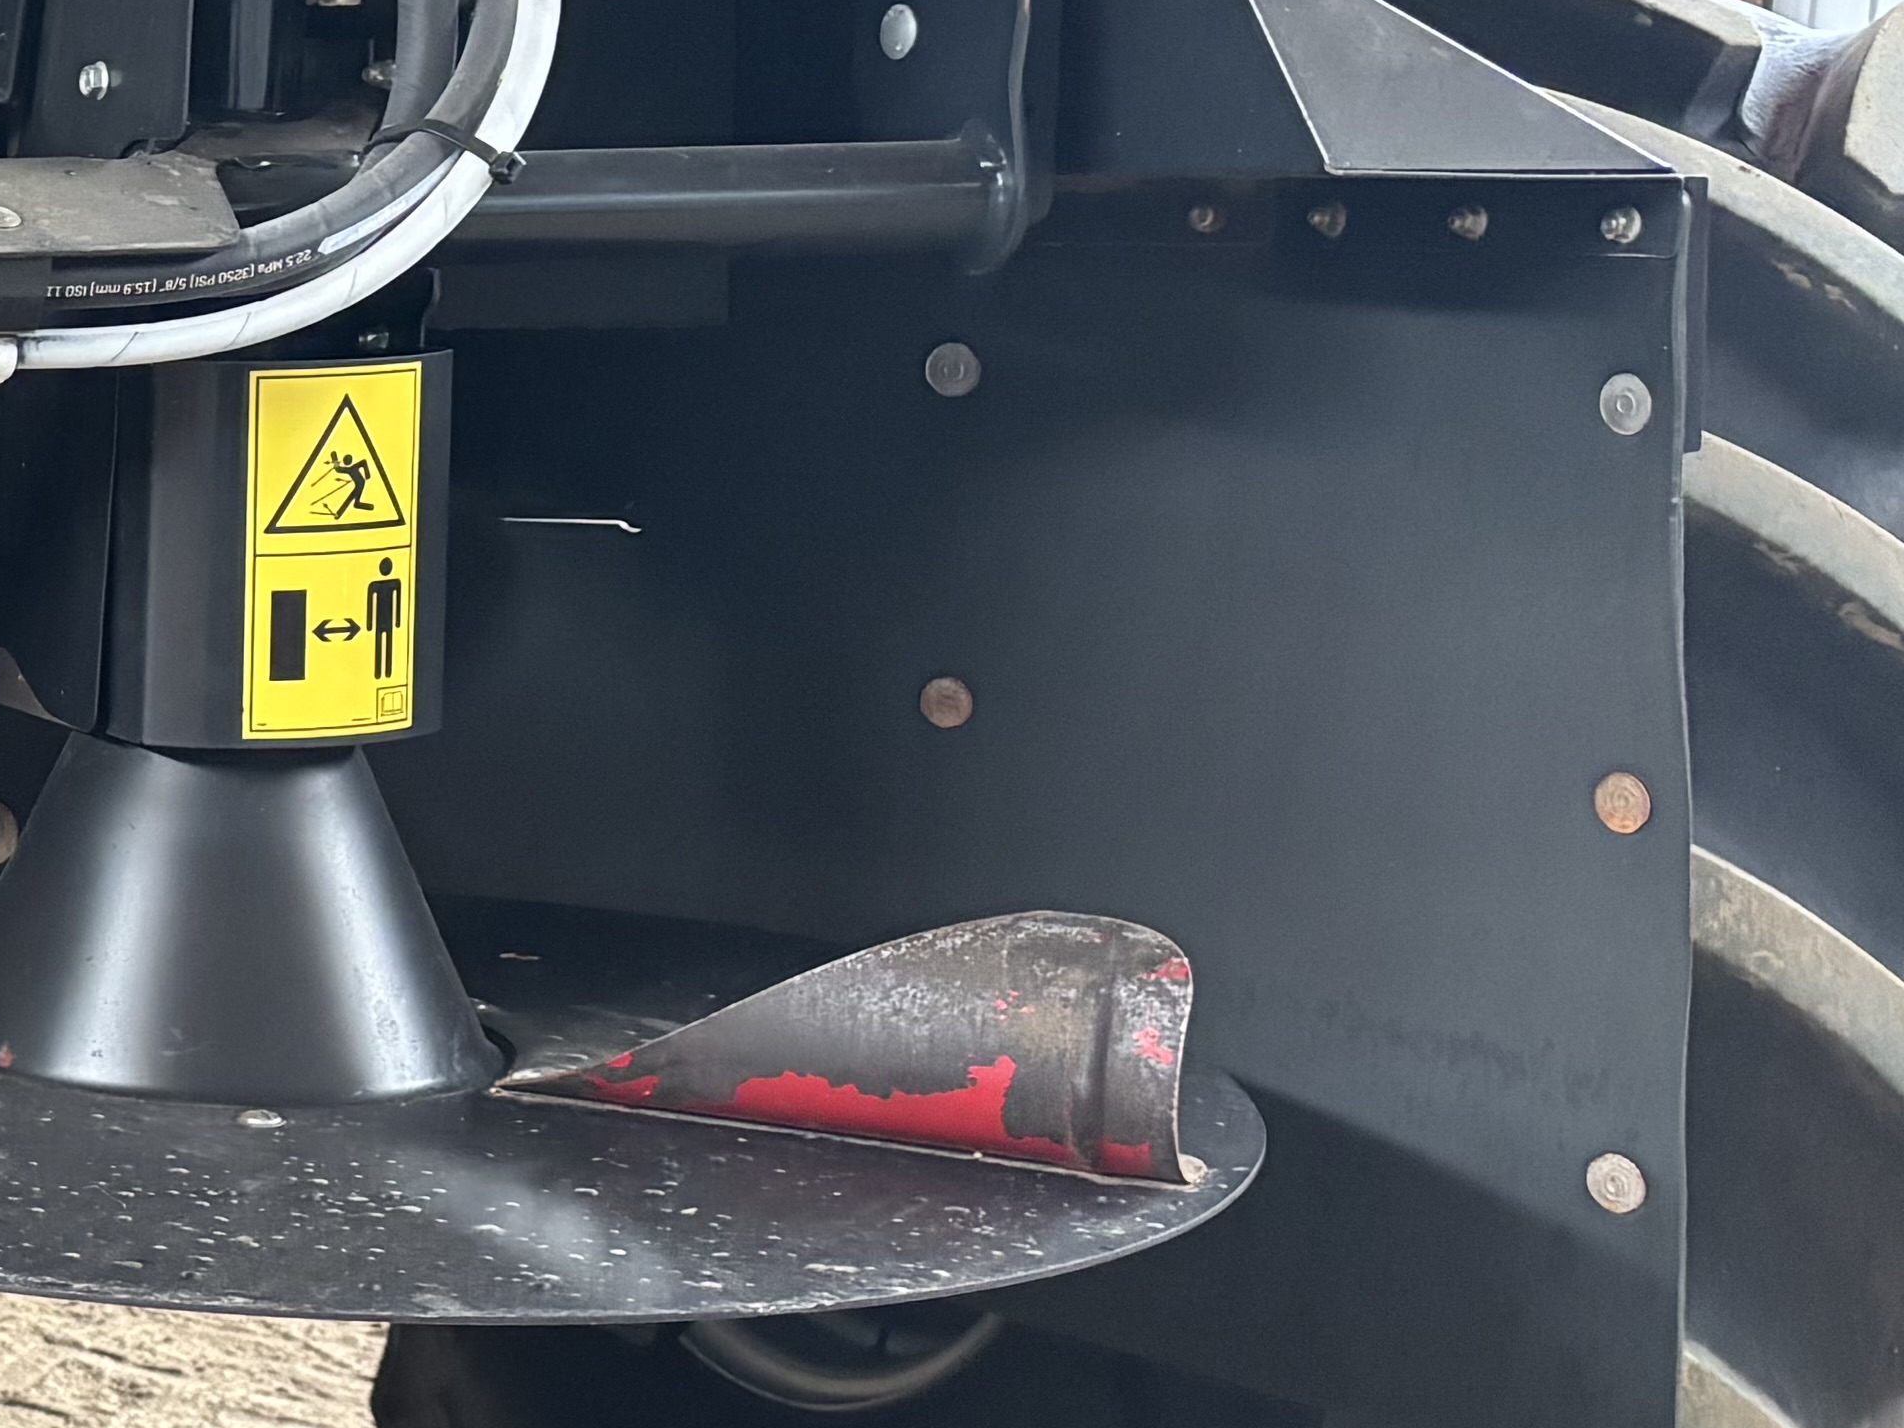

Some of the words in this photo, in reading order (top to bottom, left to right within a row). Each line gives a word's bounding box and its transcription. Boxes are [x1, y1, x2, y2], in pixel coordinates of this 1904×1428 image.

[286, 248, 313, 267] 22.5
[257, 258, 284, 275] MPa
[64, 285, 88, 298] ISO
